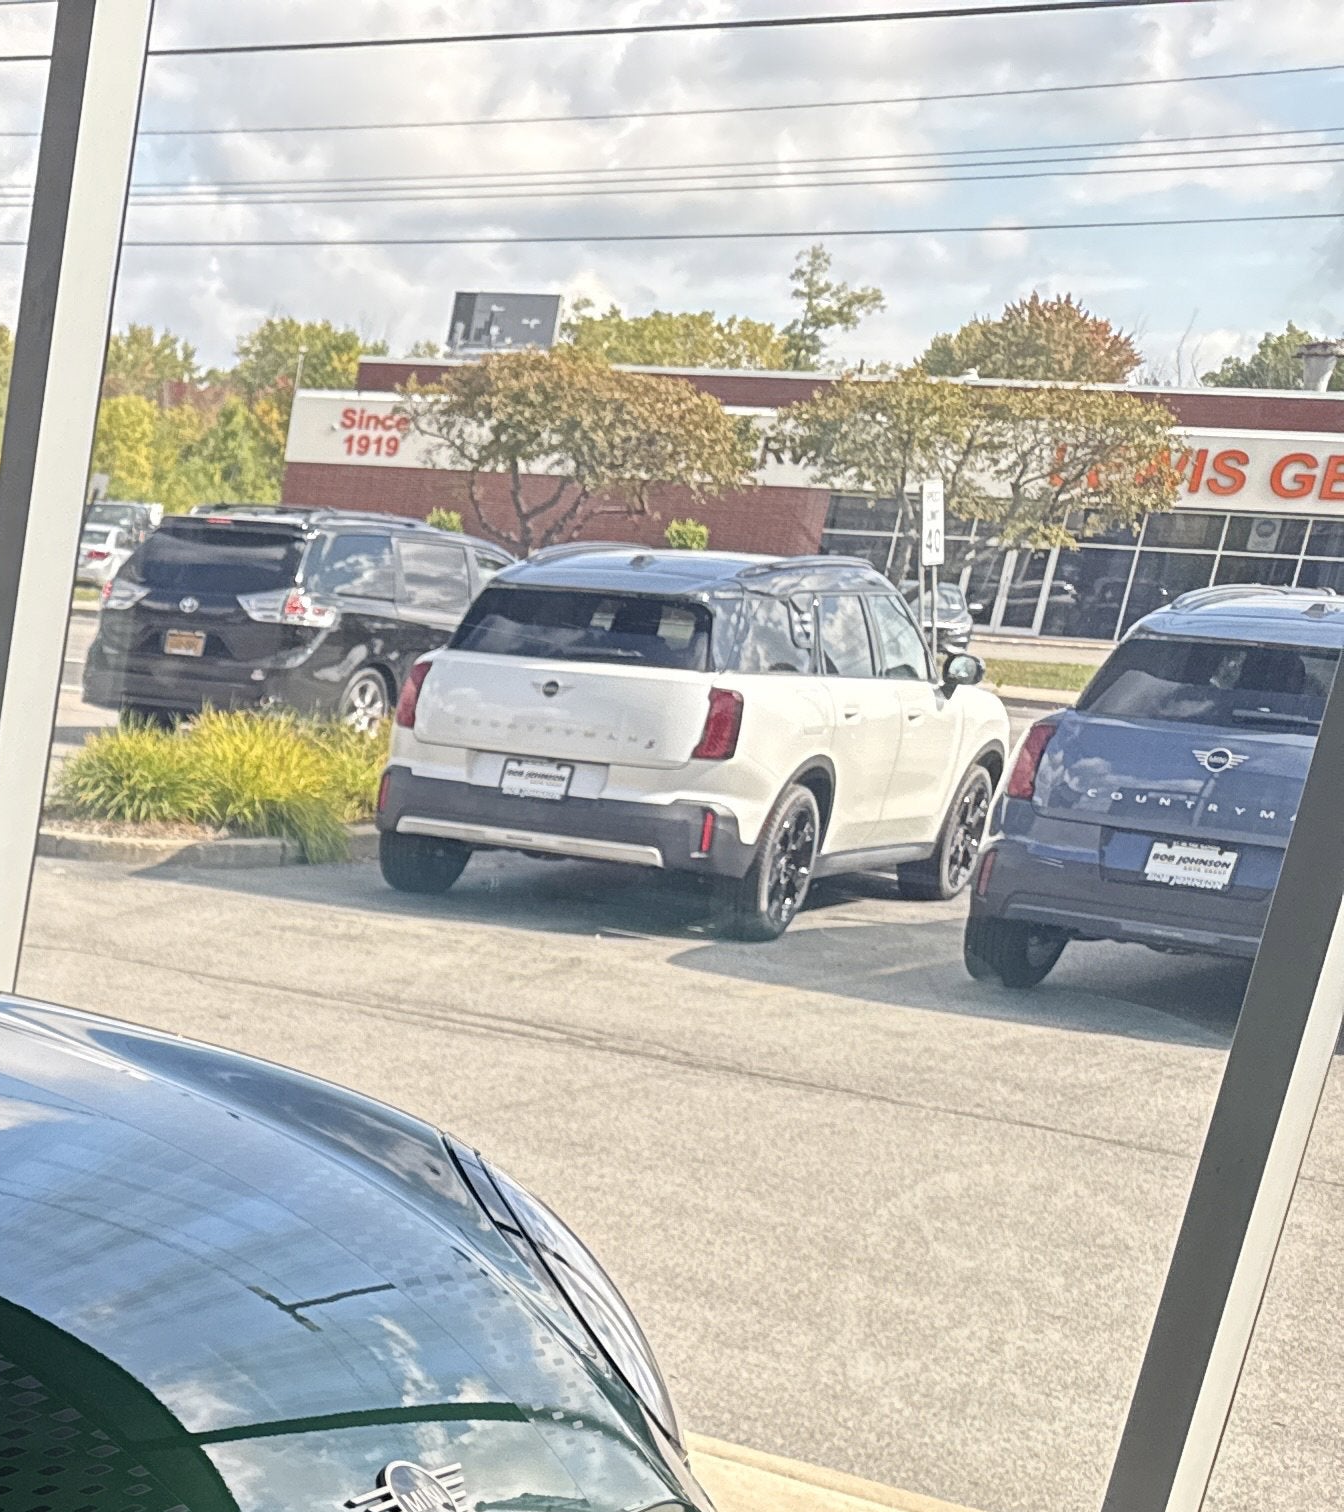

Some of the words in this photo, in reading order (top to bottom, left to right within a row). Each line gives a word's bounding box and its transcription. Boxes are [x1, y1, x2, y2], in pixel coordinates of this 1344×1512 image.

[340, 408, 411, 432] Since
[343, 435, 400, 457] 1919
[1152, 852, 1176, 863] BOB
[1176, 855, 1232, 870] JOHNSON
